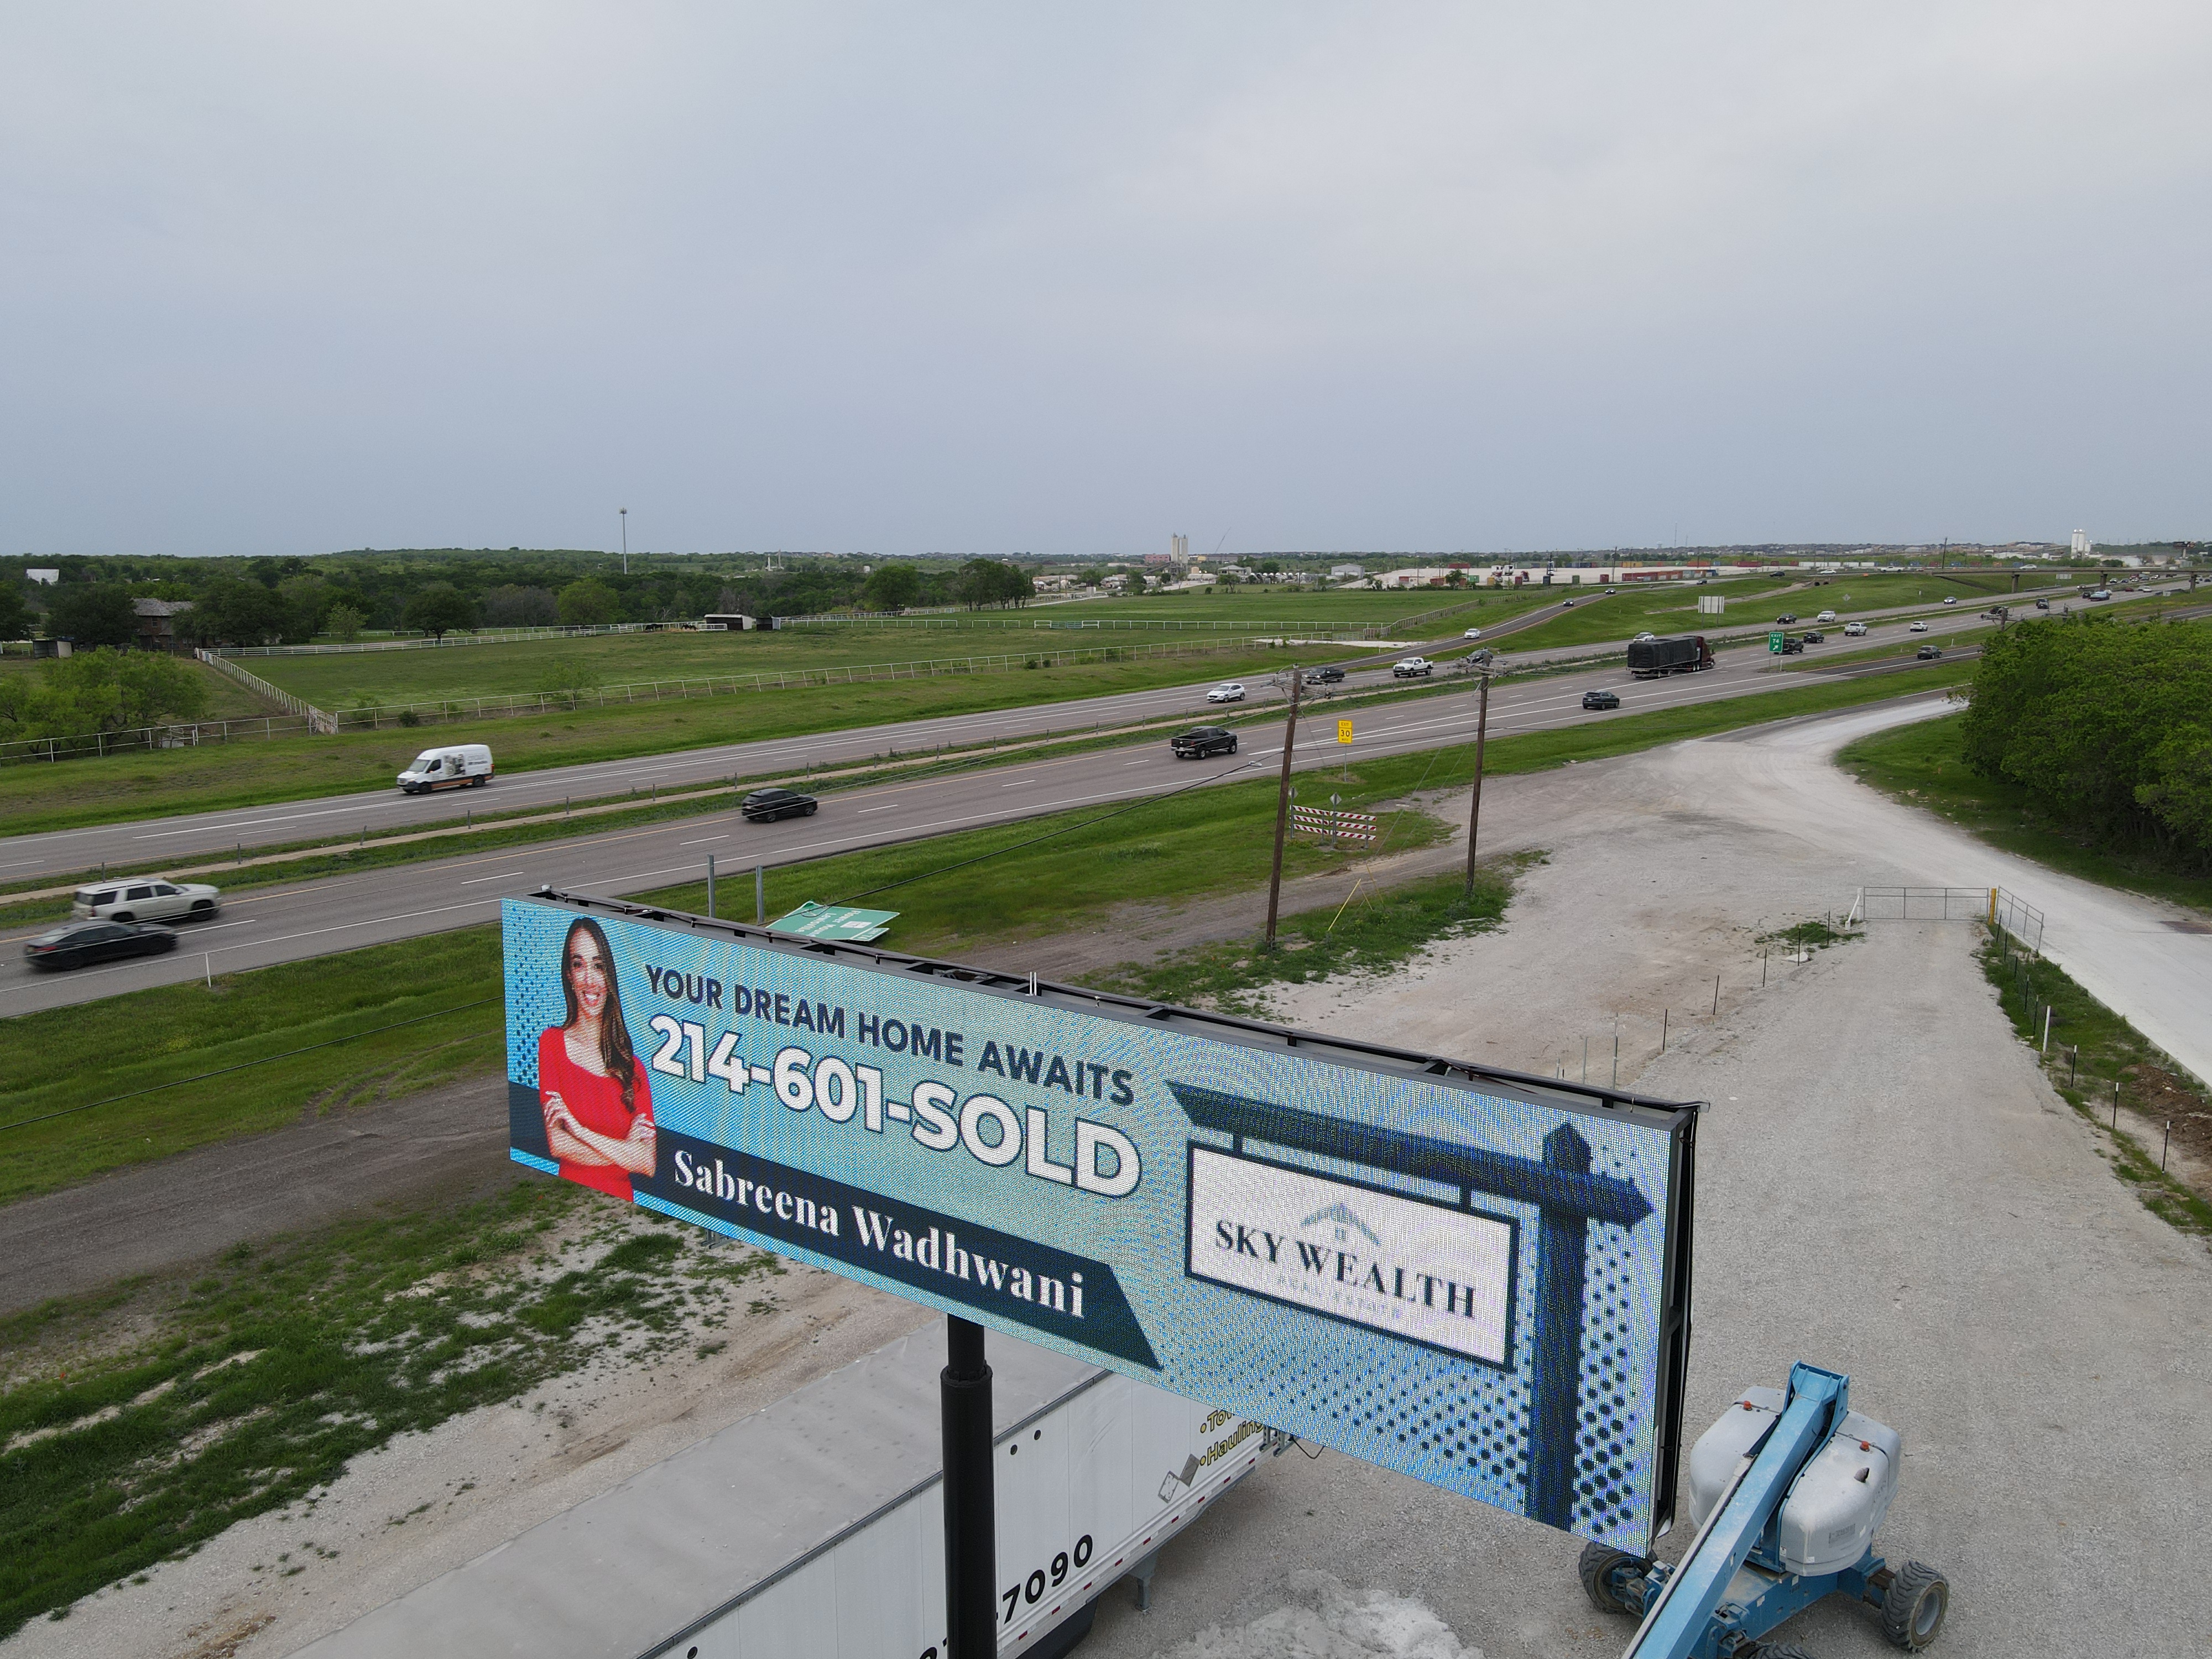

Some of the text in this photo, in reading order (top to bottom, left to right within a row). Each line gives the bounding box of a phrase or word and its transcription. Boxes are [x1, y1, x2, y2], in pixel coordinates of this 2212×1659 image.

[794, 913, 837, 932] Lewisville
[832, 910, 862, 923] Flower
[646, 964, 1135, 1106] YOUR DREAM HOME AWAITS
[649, 1014, 1141, 1198] 214-601-SOLD
[673, 1150, 1085, 1318] Sabreena Wadhwani
[1215, 1219, 1475, 1318] SKY WEALTH
